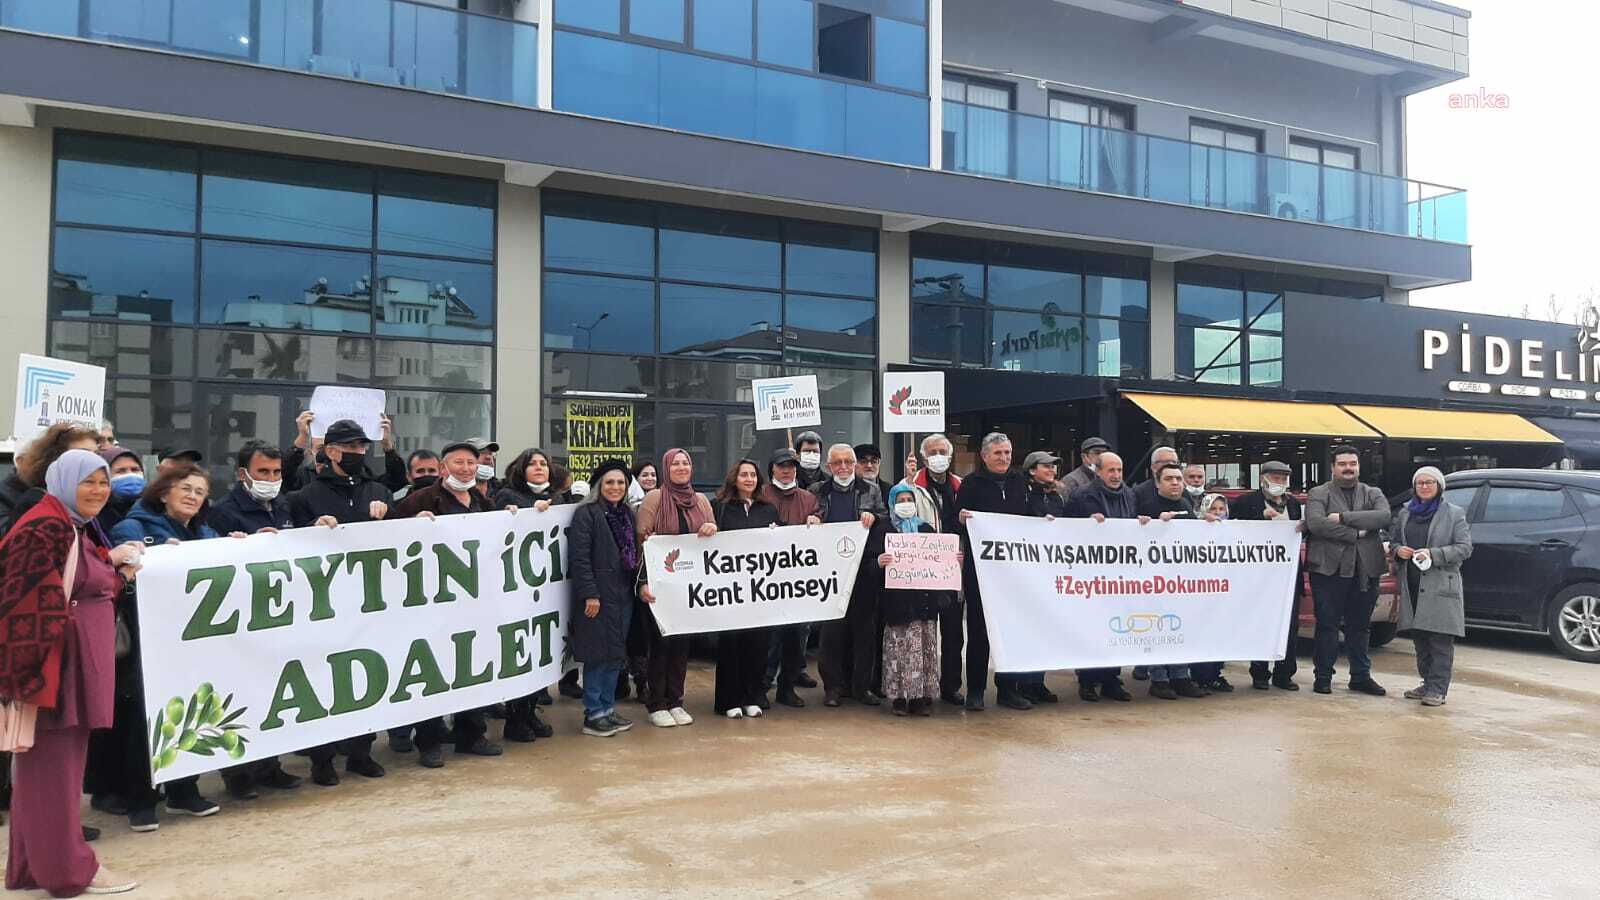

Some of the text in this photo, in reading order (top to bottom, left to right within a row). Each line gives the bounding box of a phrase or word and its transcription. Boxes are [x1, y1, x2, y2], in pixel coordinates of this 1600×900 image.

[56, 394, 97, 418] KONAK
[782, 396, 814, 411] KONAK
[569, 454, 591, 470] 0532
[703, 543, 819, 577] Karşıyaka
[980, 537, 1292, 570] ZEYTİN YAŞAMDIR, ÖLÜMSÜZLÜKTÜR.
[182, 540, 480, 641] ZEYTİN
[688, 570, 838, 609] Kent Konseyi
[1055, 575, 1230, 599] #ZeytinimeDokunma
[260, 611, 560, 731] ADALET
